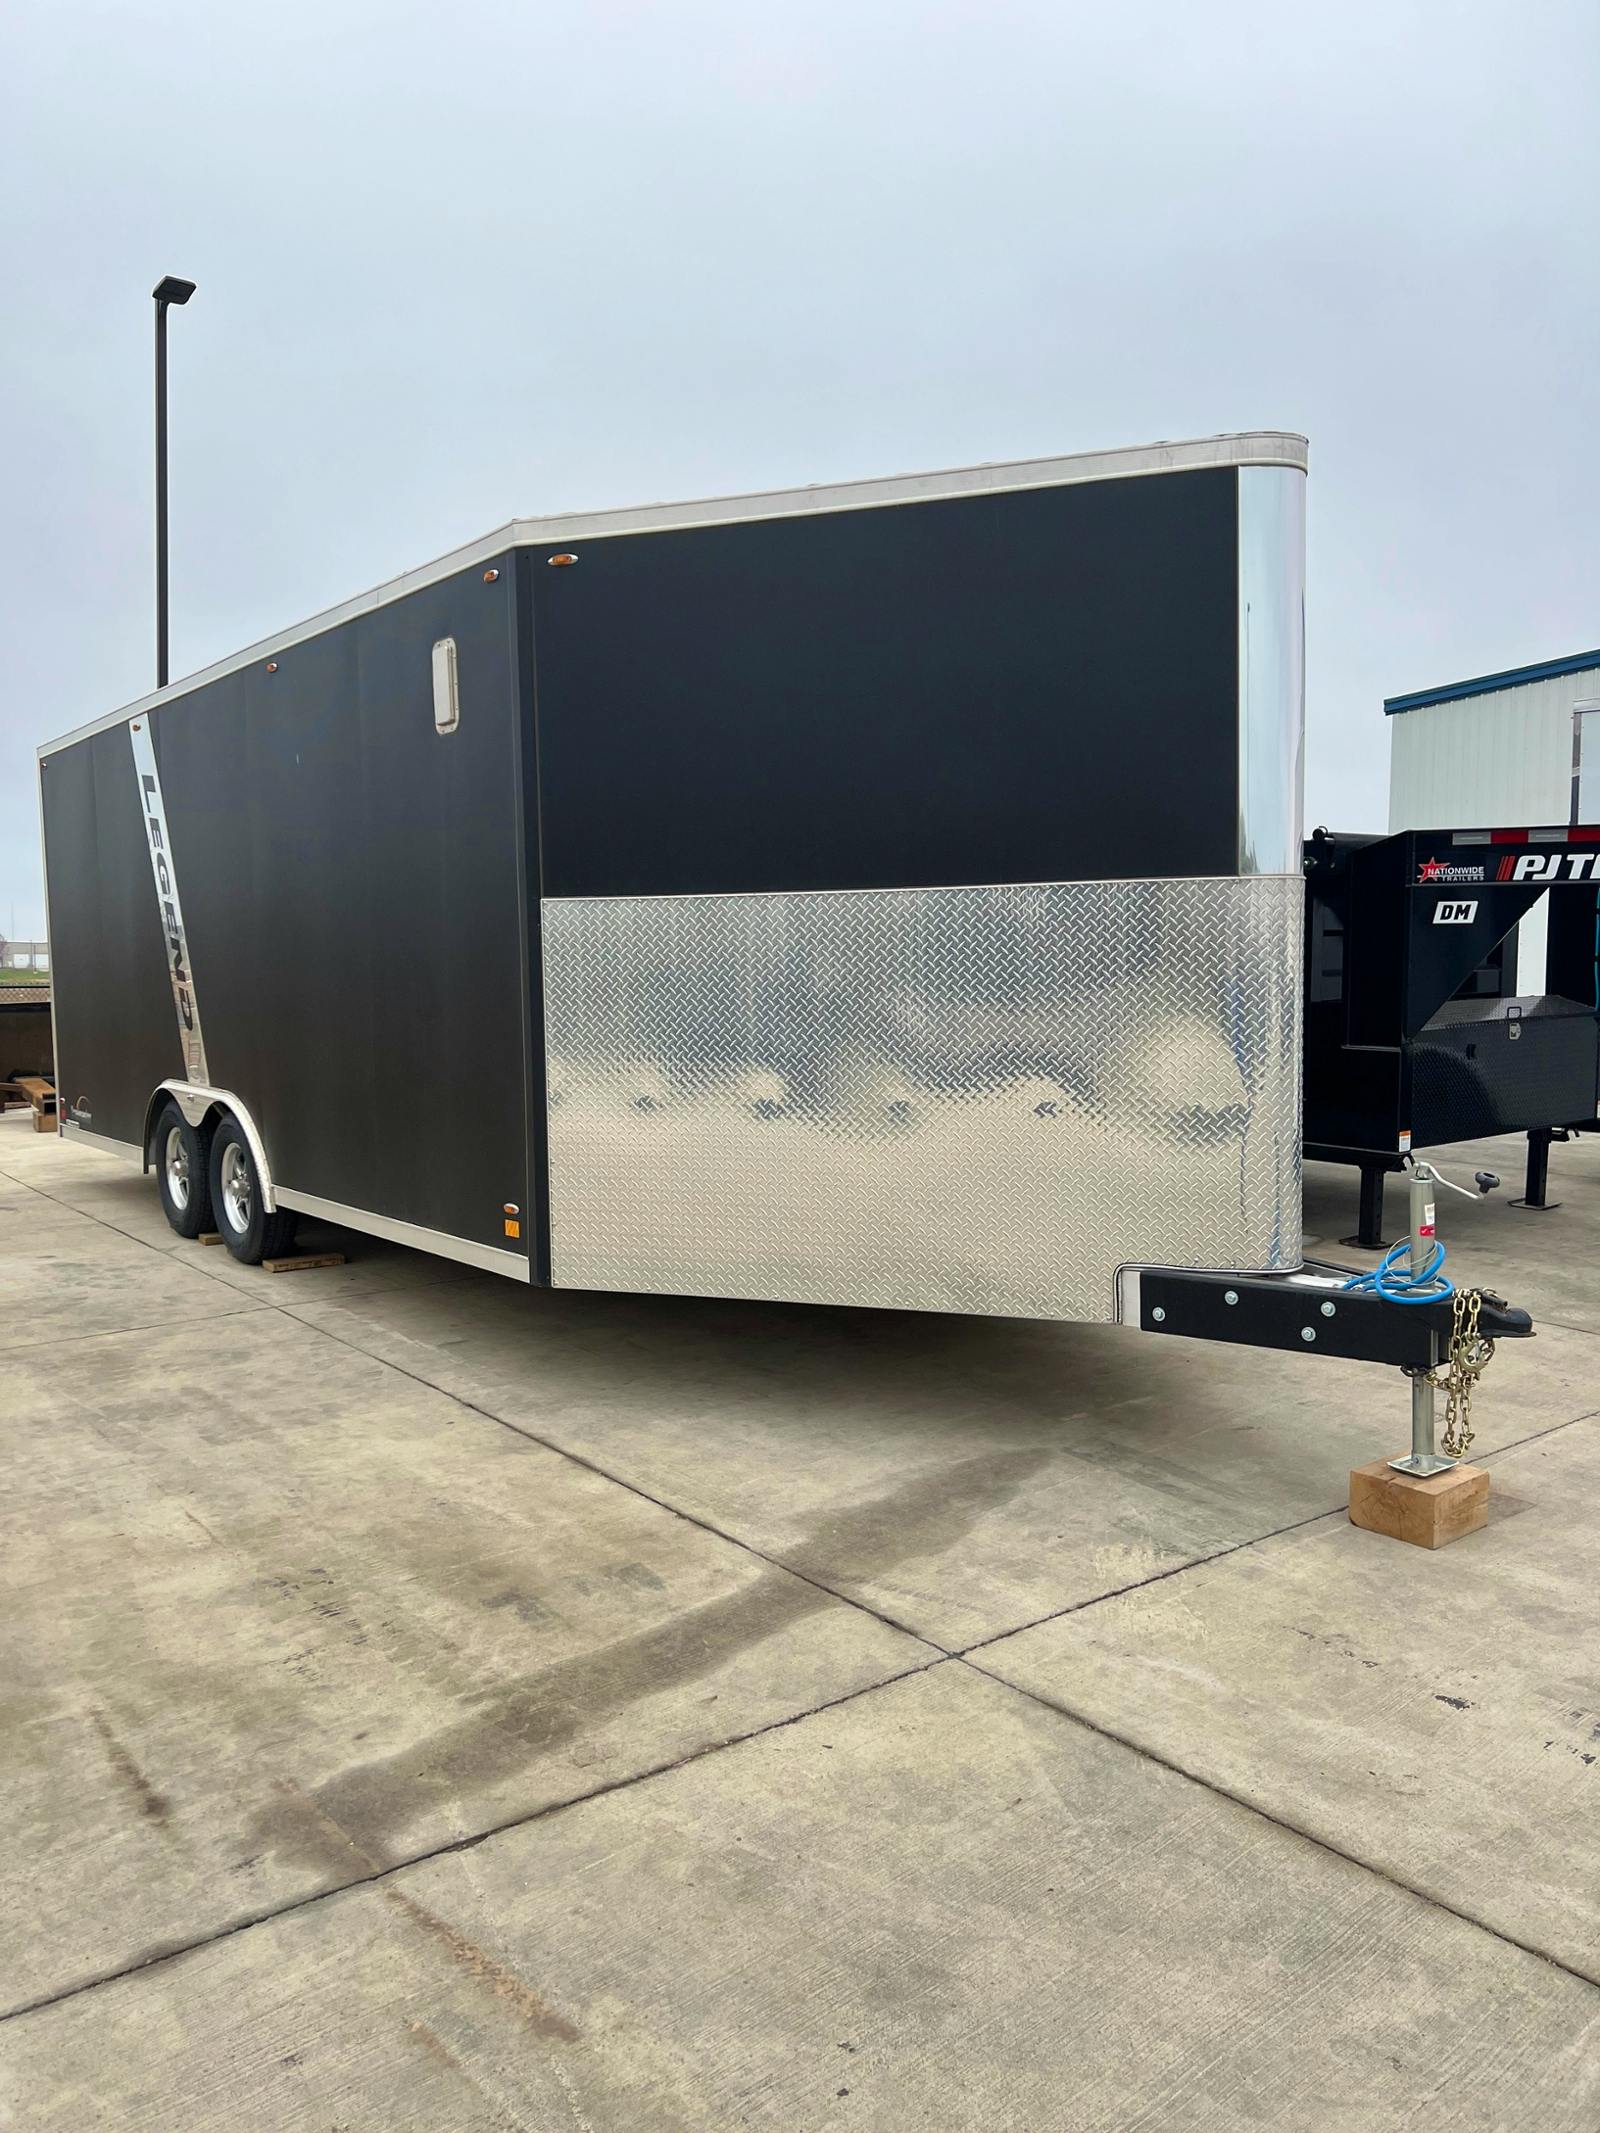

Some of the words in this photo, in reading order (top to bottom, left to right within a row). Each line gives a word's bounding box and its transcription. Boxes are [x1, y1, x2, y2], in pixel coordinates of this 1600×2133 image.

[1427, 866, 1484, 875] NATIONWIDE
[1513, 854, 1562, 880] PJ
[142, 775, 193, 1031] LEGEND
[1440, 904, 1471, 920] DM
